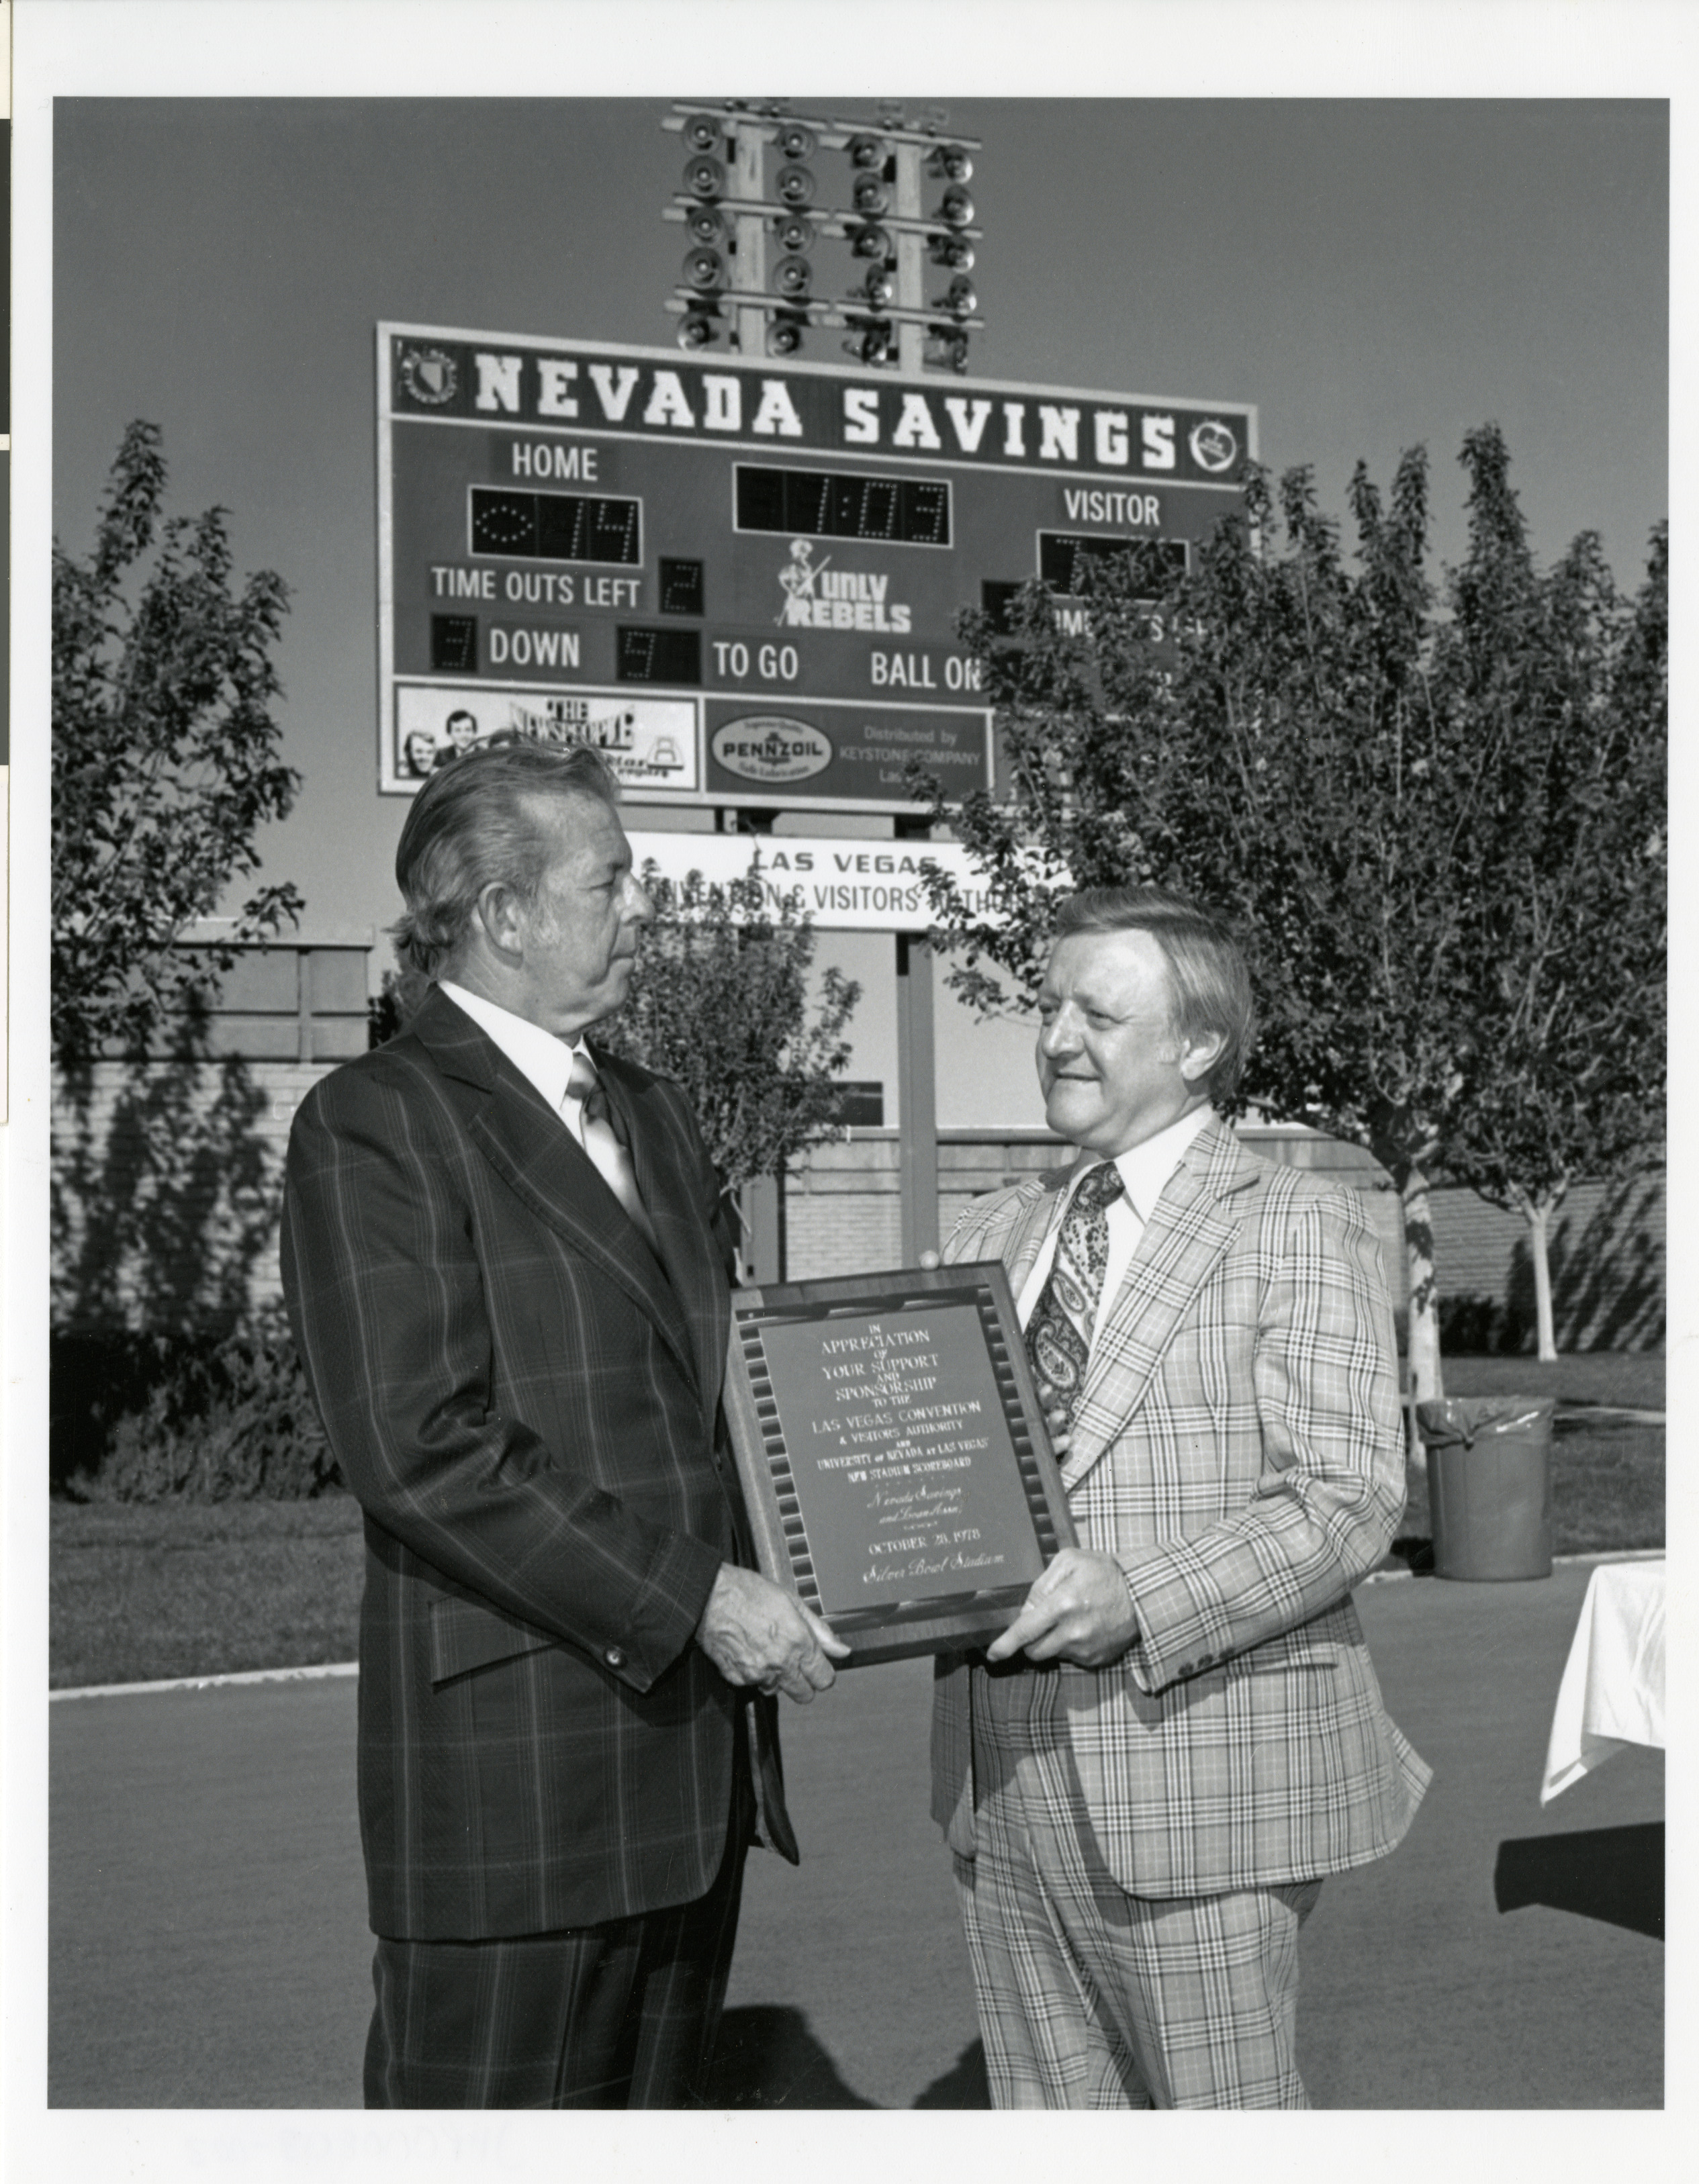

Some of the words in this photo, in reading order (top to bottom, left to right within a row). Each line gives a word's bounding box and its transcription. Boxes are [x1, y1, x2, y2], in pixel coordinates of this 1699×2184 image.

[475, 353, 803, 436] NEVADA
[844, 387, 1177, 469] SAVINGS
[512, 442, 598, 481] HOME
[1064, 487, 1160, 526] VISITOR
[570, 500, 635, 561] 14
[431, 567, 496, 600] TIME
[505, 571, 574, 604] OUTS
[584, 577, 641, 608] LEFT
[821, 571, 888, 603] UNLV
[786, 599, 911, 633] REBELS
[490, 628, 580, 667] DOWN
[713, 642, 749, 677] TO
[758, 645, 799, 681] GO
[871, 651, 937, 688] BALL
[944, 655, 982, 692] ON
[723, 741, 824, 757] PENNZOIL
[863, 724, 934, 743] Distributed
[941, 730, 958, 747] by
[840, 744, 908, 763] KEYSTONE
[911, 749, 981, 765] COMPANY
[752, 851, 815, 871] LAS
[833, 853, 937, 875] VEGAS
[813, 884, 919, 912] VISITORS
[821, 1329, 930, 1355] APPRECIATION
[868, 1323, 881, 1334] IN
[822, 1363, 866, 1380] YOUR
[871, 1353, 939, 1374] SUPPORT
[877, 1372, 900, 1384] AND
[835, 1376, 937, 1402] SPONSORSHIP
[872, 1397, 887, 1408] TO
[889, 1394, 911, 1406] THE
[811, 1419, 841, 1434] LAS
[845, 1411, 893, 1429] VEGAS
[898, 1399, 981, 1423] CONVENTION
[851, 1427, 901, 1444] VISITORS
[906, 1419, 963, 1437] AUTHORITY
[817, 1452, 871, 1471] UNIVERSITY
[886, 1445, 923, 1462] NEVADA
[937, 1441, 956, 1455] LAS
[869, 1464, 911, 1480] STADIUM
[912, 1455, 972, 1474] SCOREBOARD
[868, 1535, 927, 1556] OCTOBER
[952, 1527, 981, 1543] 1978
[862, 1564, 906, 1584] Silver
[908, 1557, 950, 1576] Bowl
[949, 1551, 1005, 1570] Stadium
